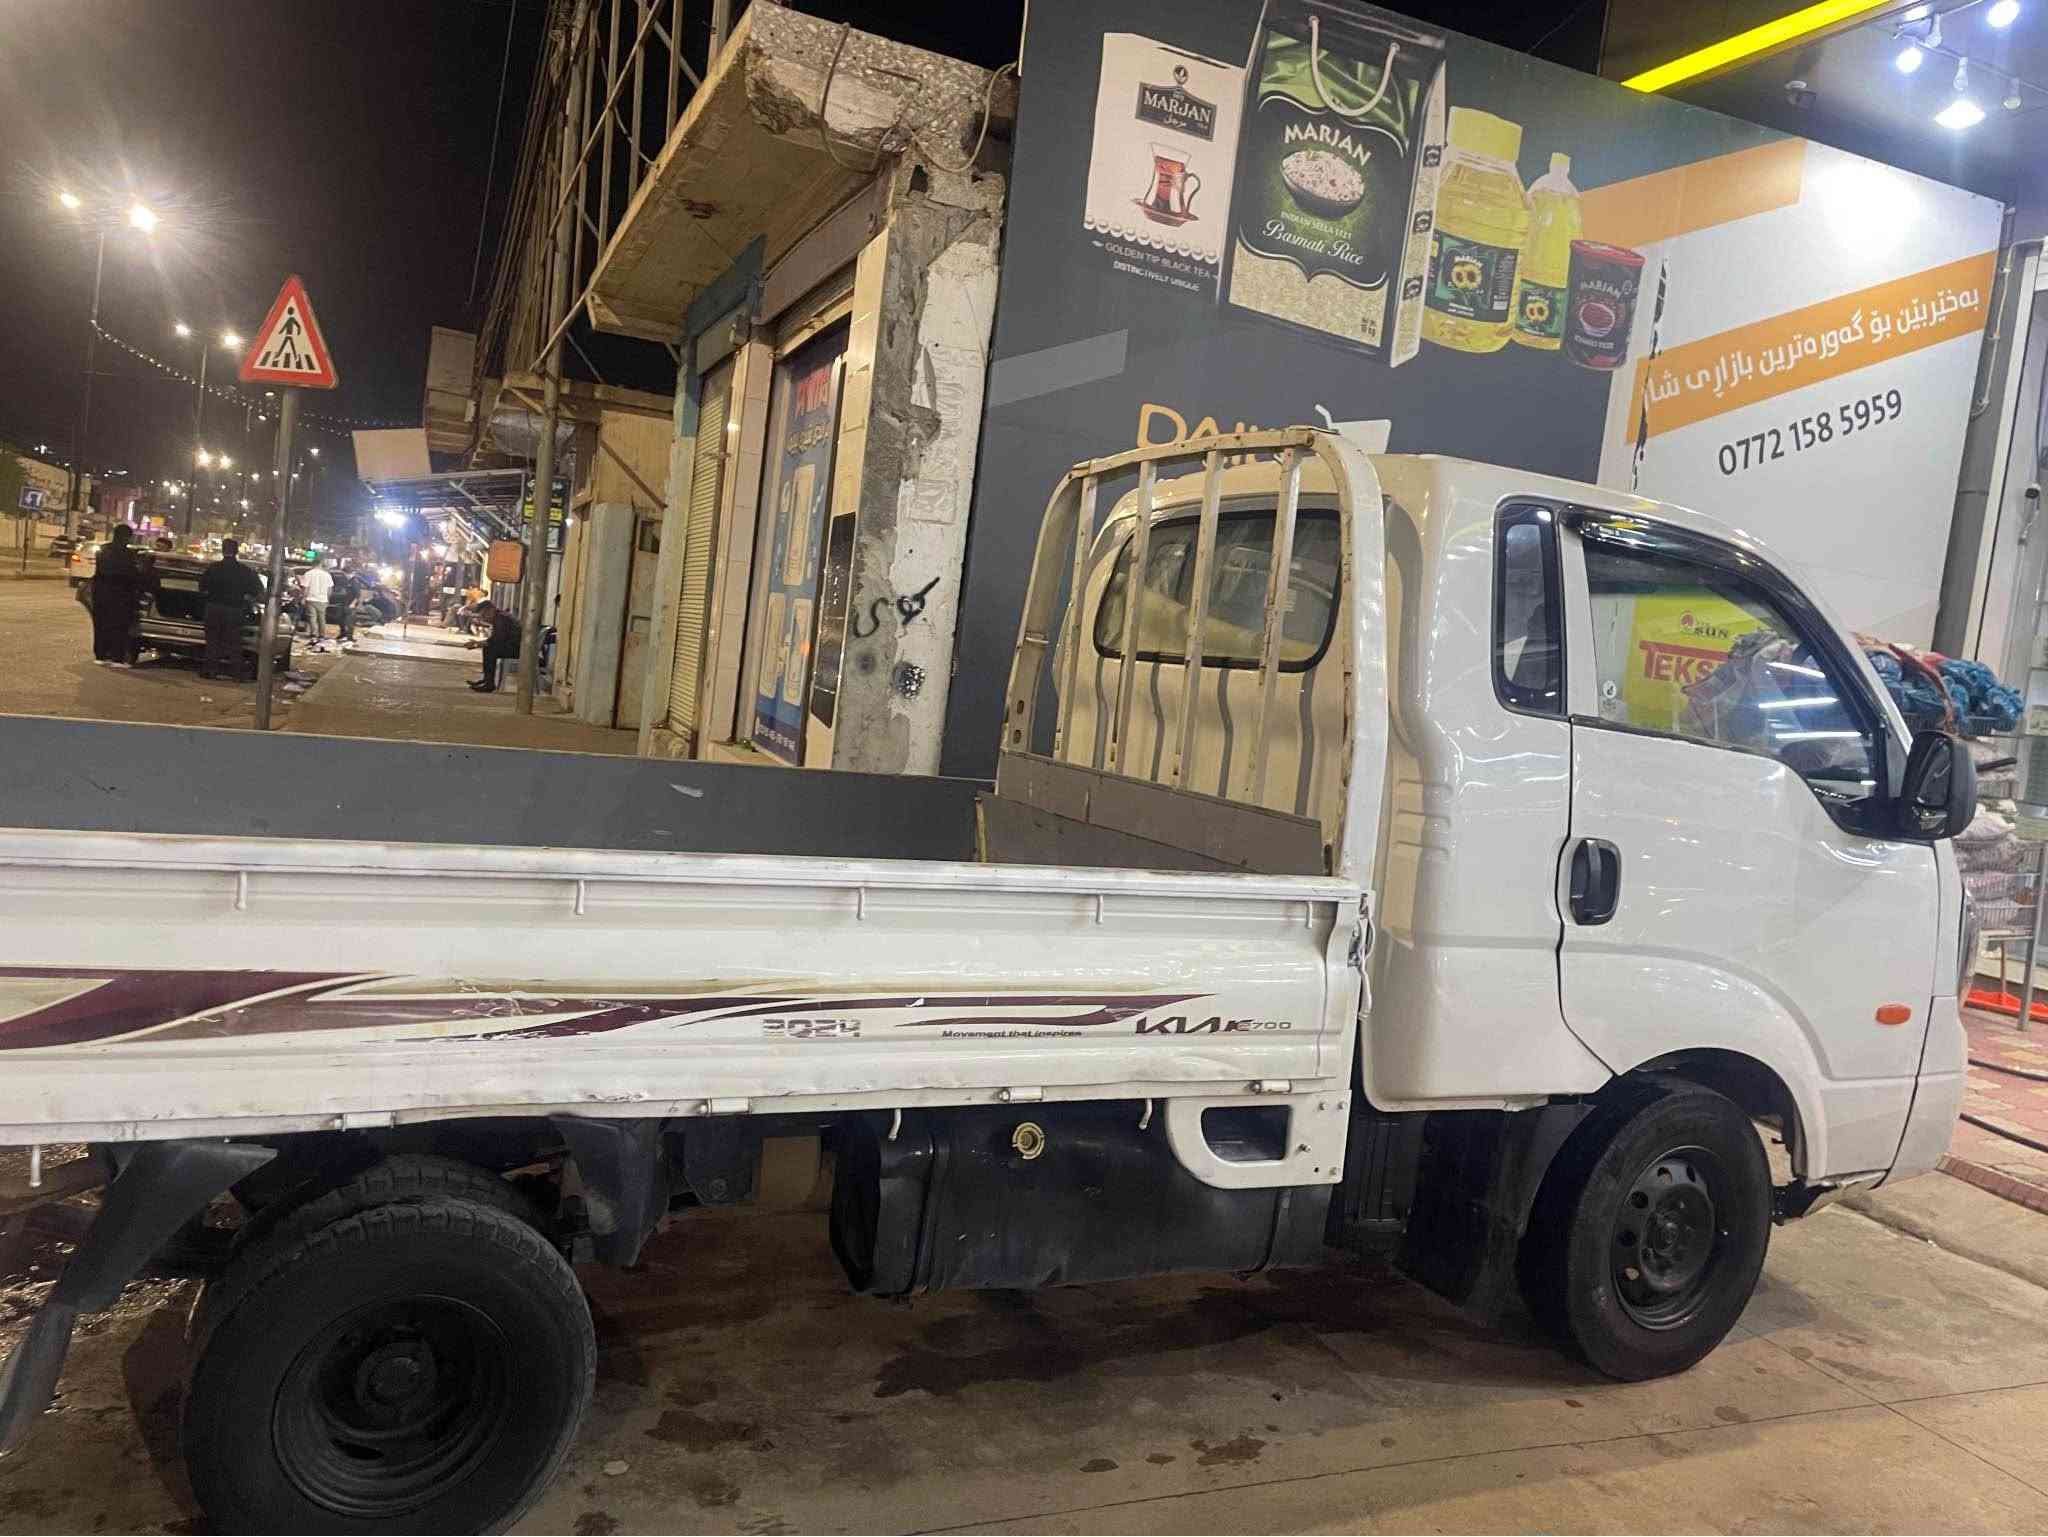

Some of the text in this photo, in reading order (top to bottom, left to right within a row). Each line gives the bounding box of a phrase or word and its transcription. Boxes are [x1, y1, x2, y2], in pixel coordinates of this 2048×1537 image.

[1143, 90, 1212, 122] MARJAN
[1284, 121, 1372, 166] MARJAN
[1104, 241, 1144, 260] GOLDEN
[1160, 258, 1192, 272] BLACK
[1193, 267, 1211, 279] TEA
[1262, 219, 1365, 265] Basmati Rice
[1718, 388, 1903, 477] 0772 158 5959
[1136, 1016, 1221, 1034] KIA
